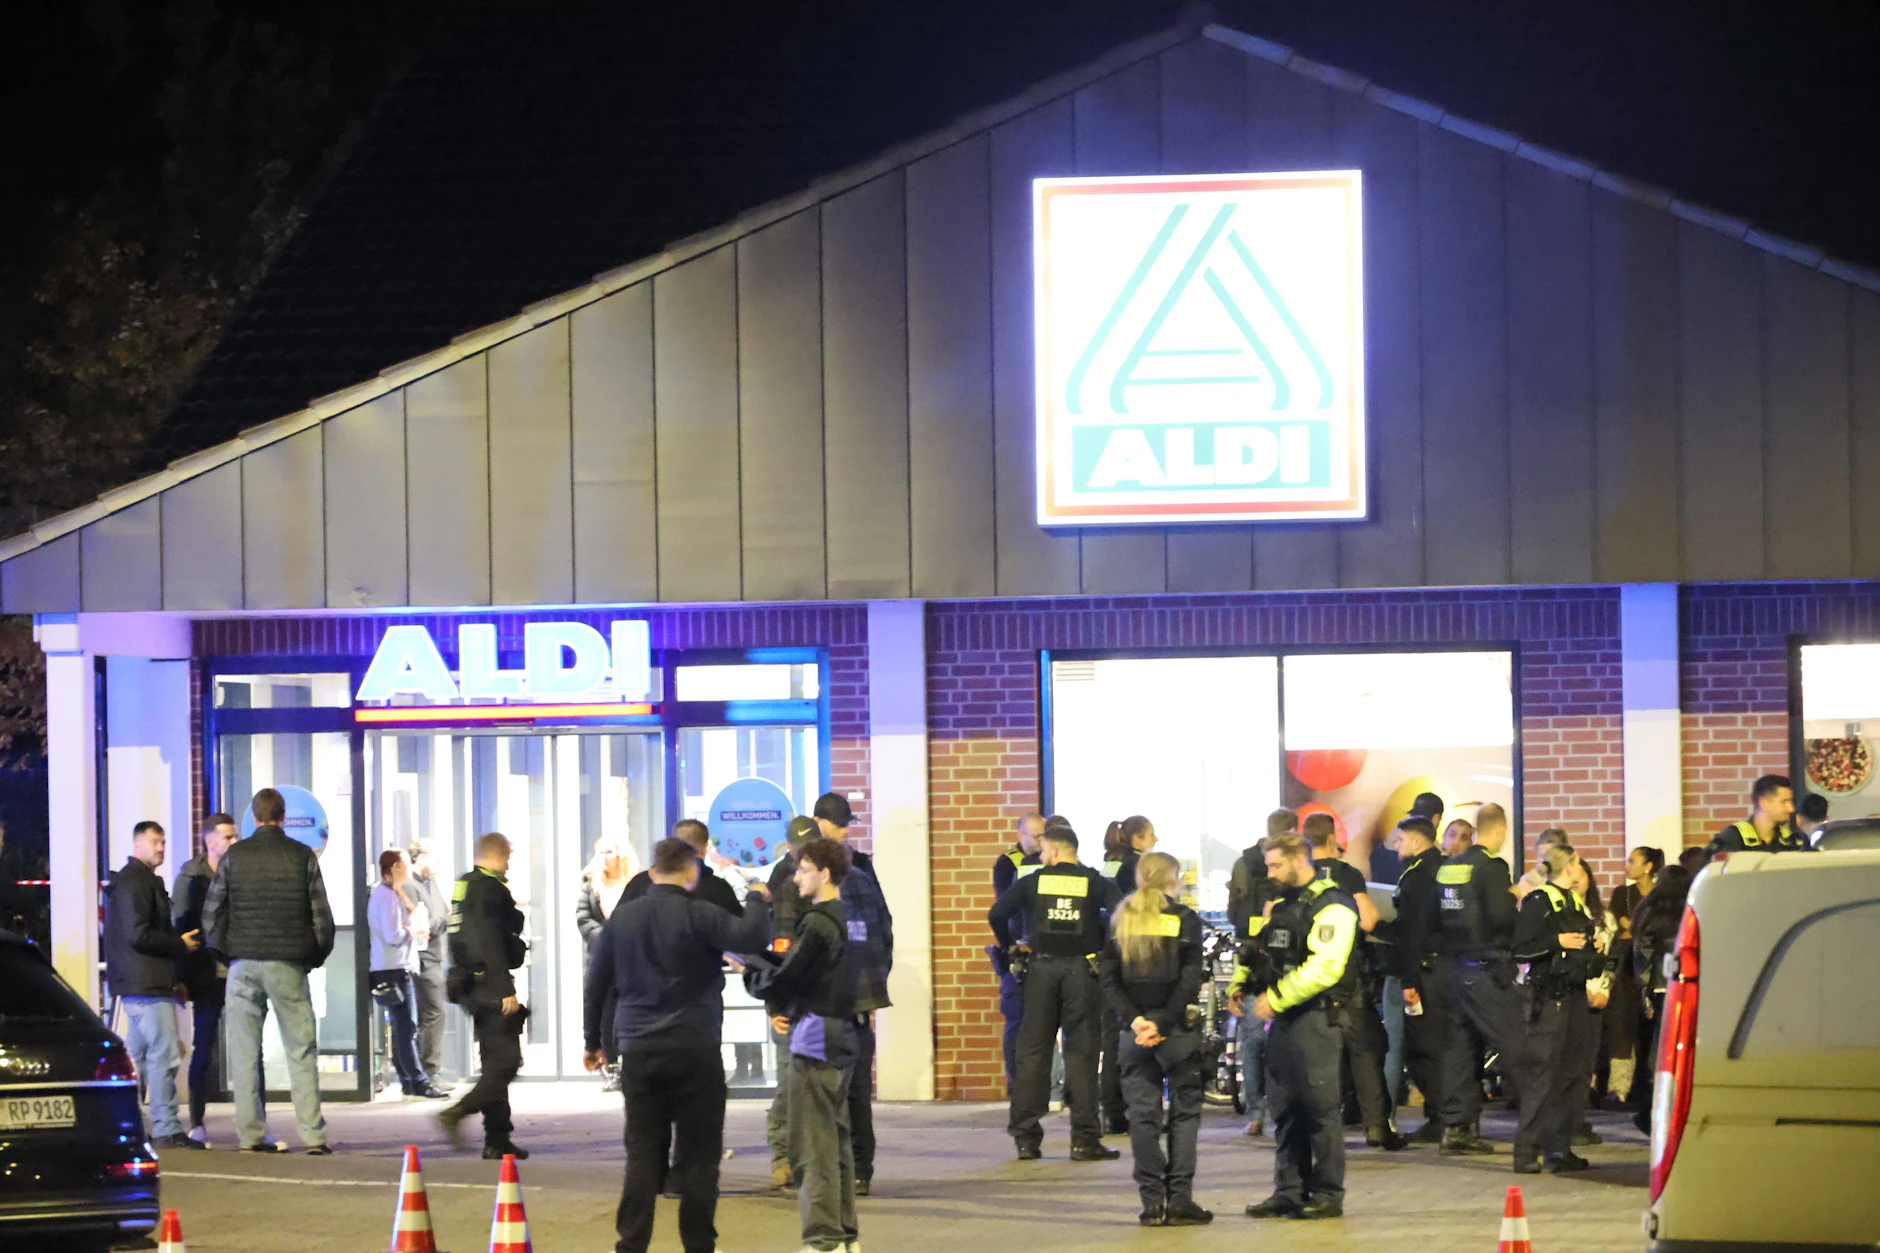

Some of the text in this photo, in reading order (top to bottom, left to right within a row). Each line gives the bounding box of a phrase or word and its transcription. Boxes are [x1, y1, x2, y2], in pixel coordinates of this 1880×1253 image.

[1087, 425, 1310, 487] ALDI
[355, 620, 649, 700] ALDI
[722, 812, 779, 820] WILLKOMMEN.
[1056, 898, 1073, 909] BE
[1047, 908, 1081, 920] 35214
[8, 1099, 74, 1121] RP 9182
